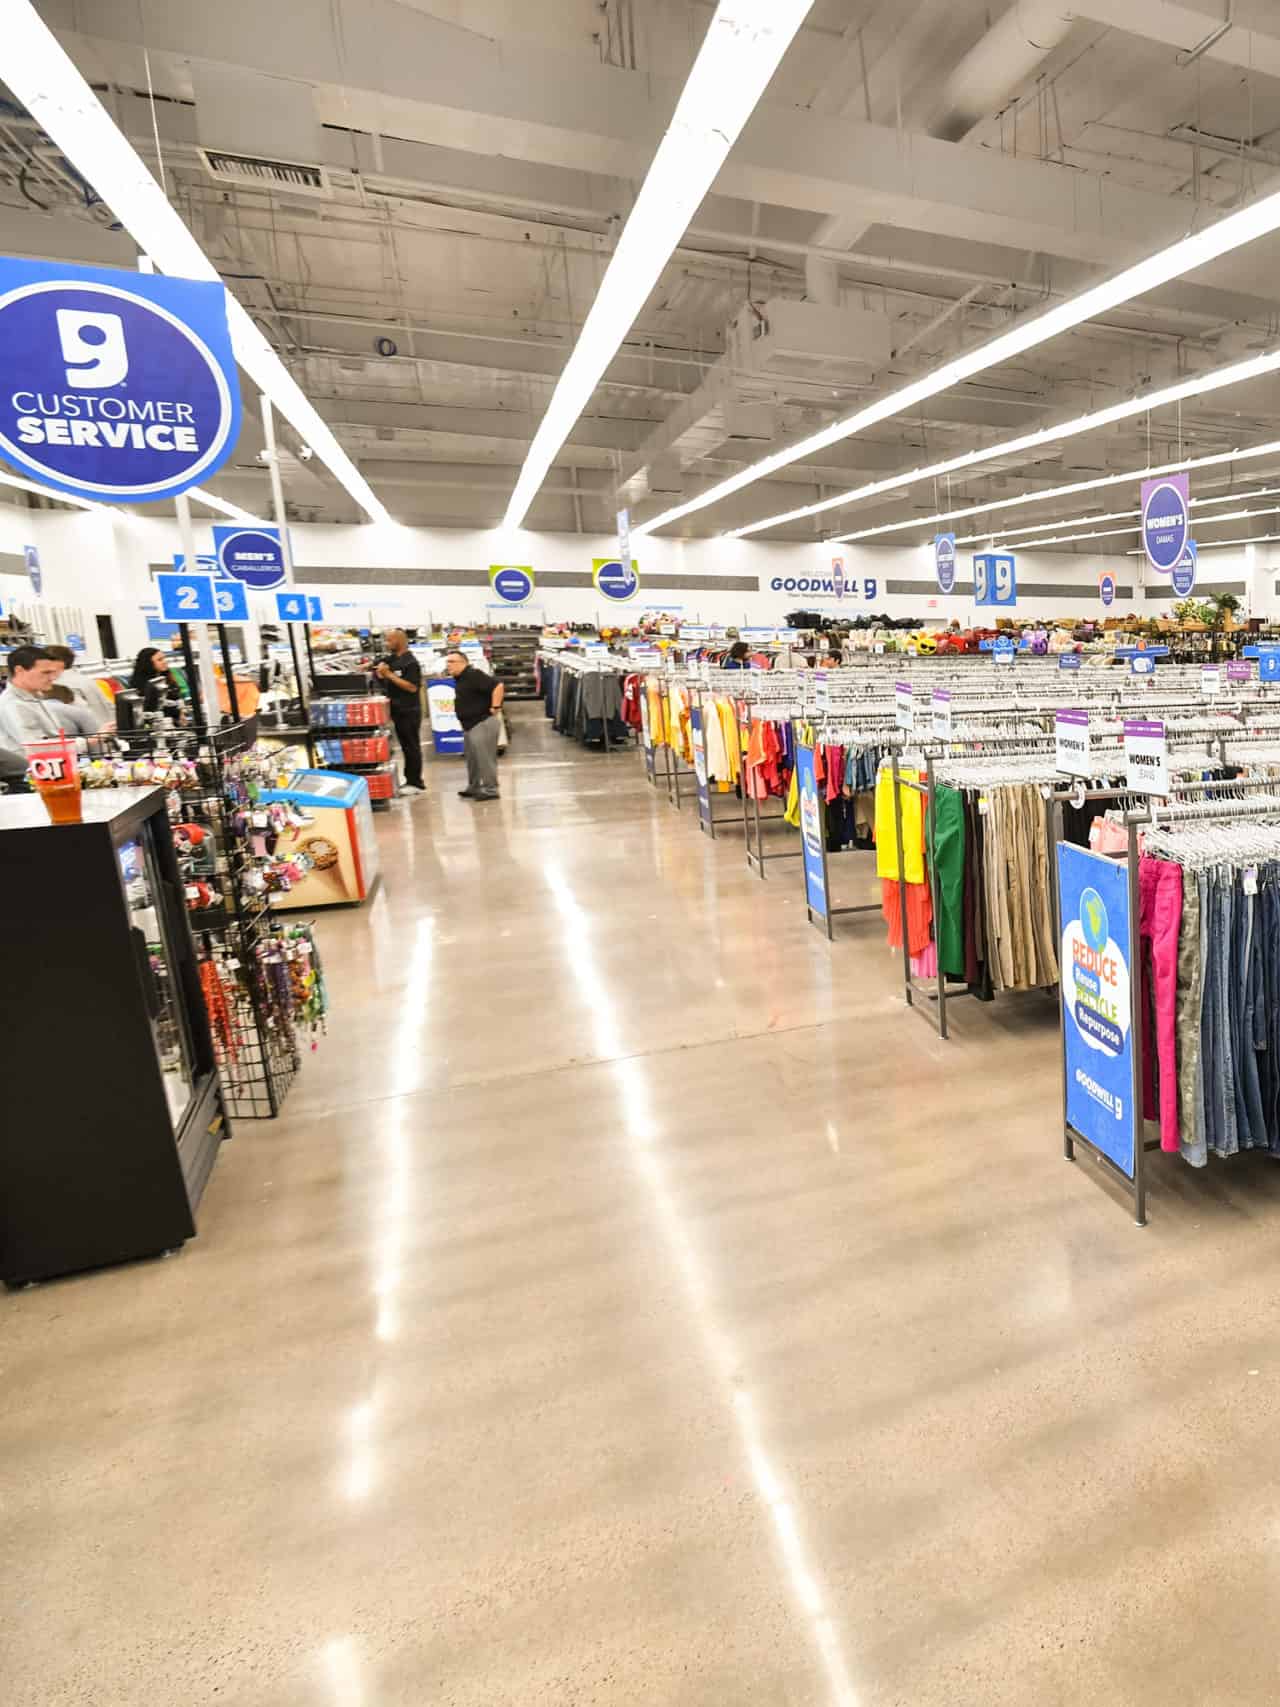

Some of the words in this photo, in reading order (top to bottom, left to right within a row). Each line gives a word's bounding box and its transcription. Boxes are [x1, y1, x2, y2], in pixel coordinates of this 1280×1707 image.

[11, 391, 194, 424] CUSTOMER
[15, 418, 200, 453] SERVICE
[1146, 514, 1184, 530] WOMEN'S
[770, 577, 859, 592] GOODWLL
[176, 586, 200, 609] 2
[216, 591, 234, 611] 3
[285, 600, 300, 615] 4
[31, 758, 64, 781] QT
[1129, 754, 1161, 767] WOMEN'S
[1072, 936, 1118, 987] REDUCE
[1079, 1007, 1120, 1046] Repurpose
